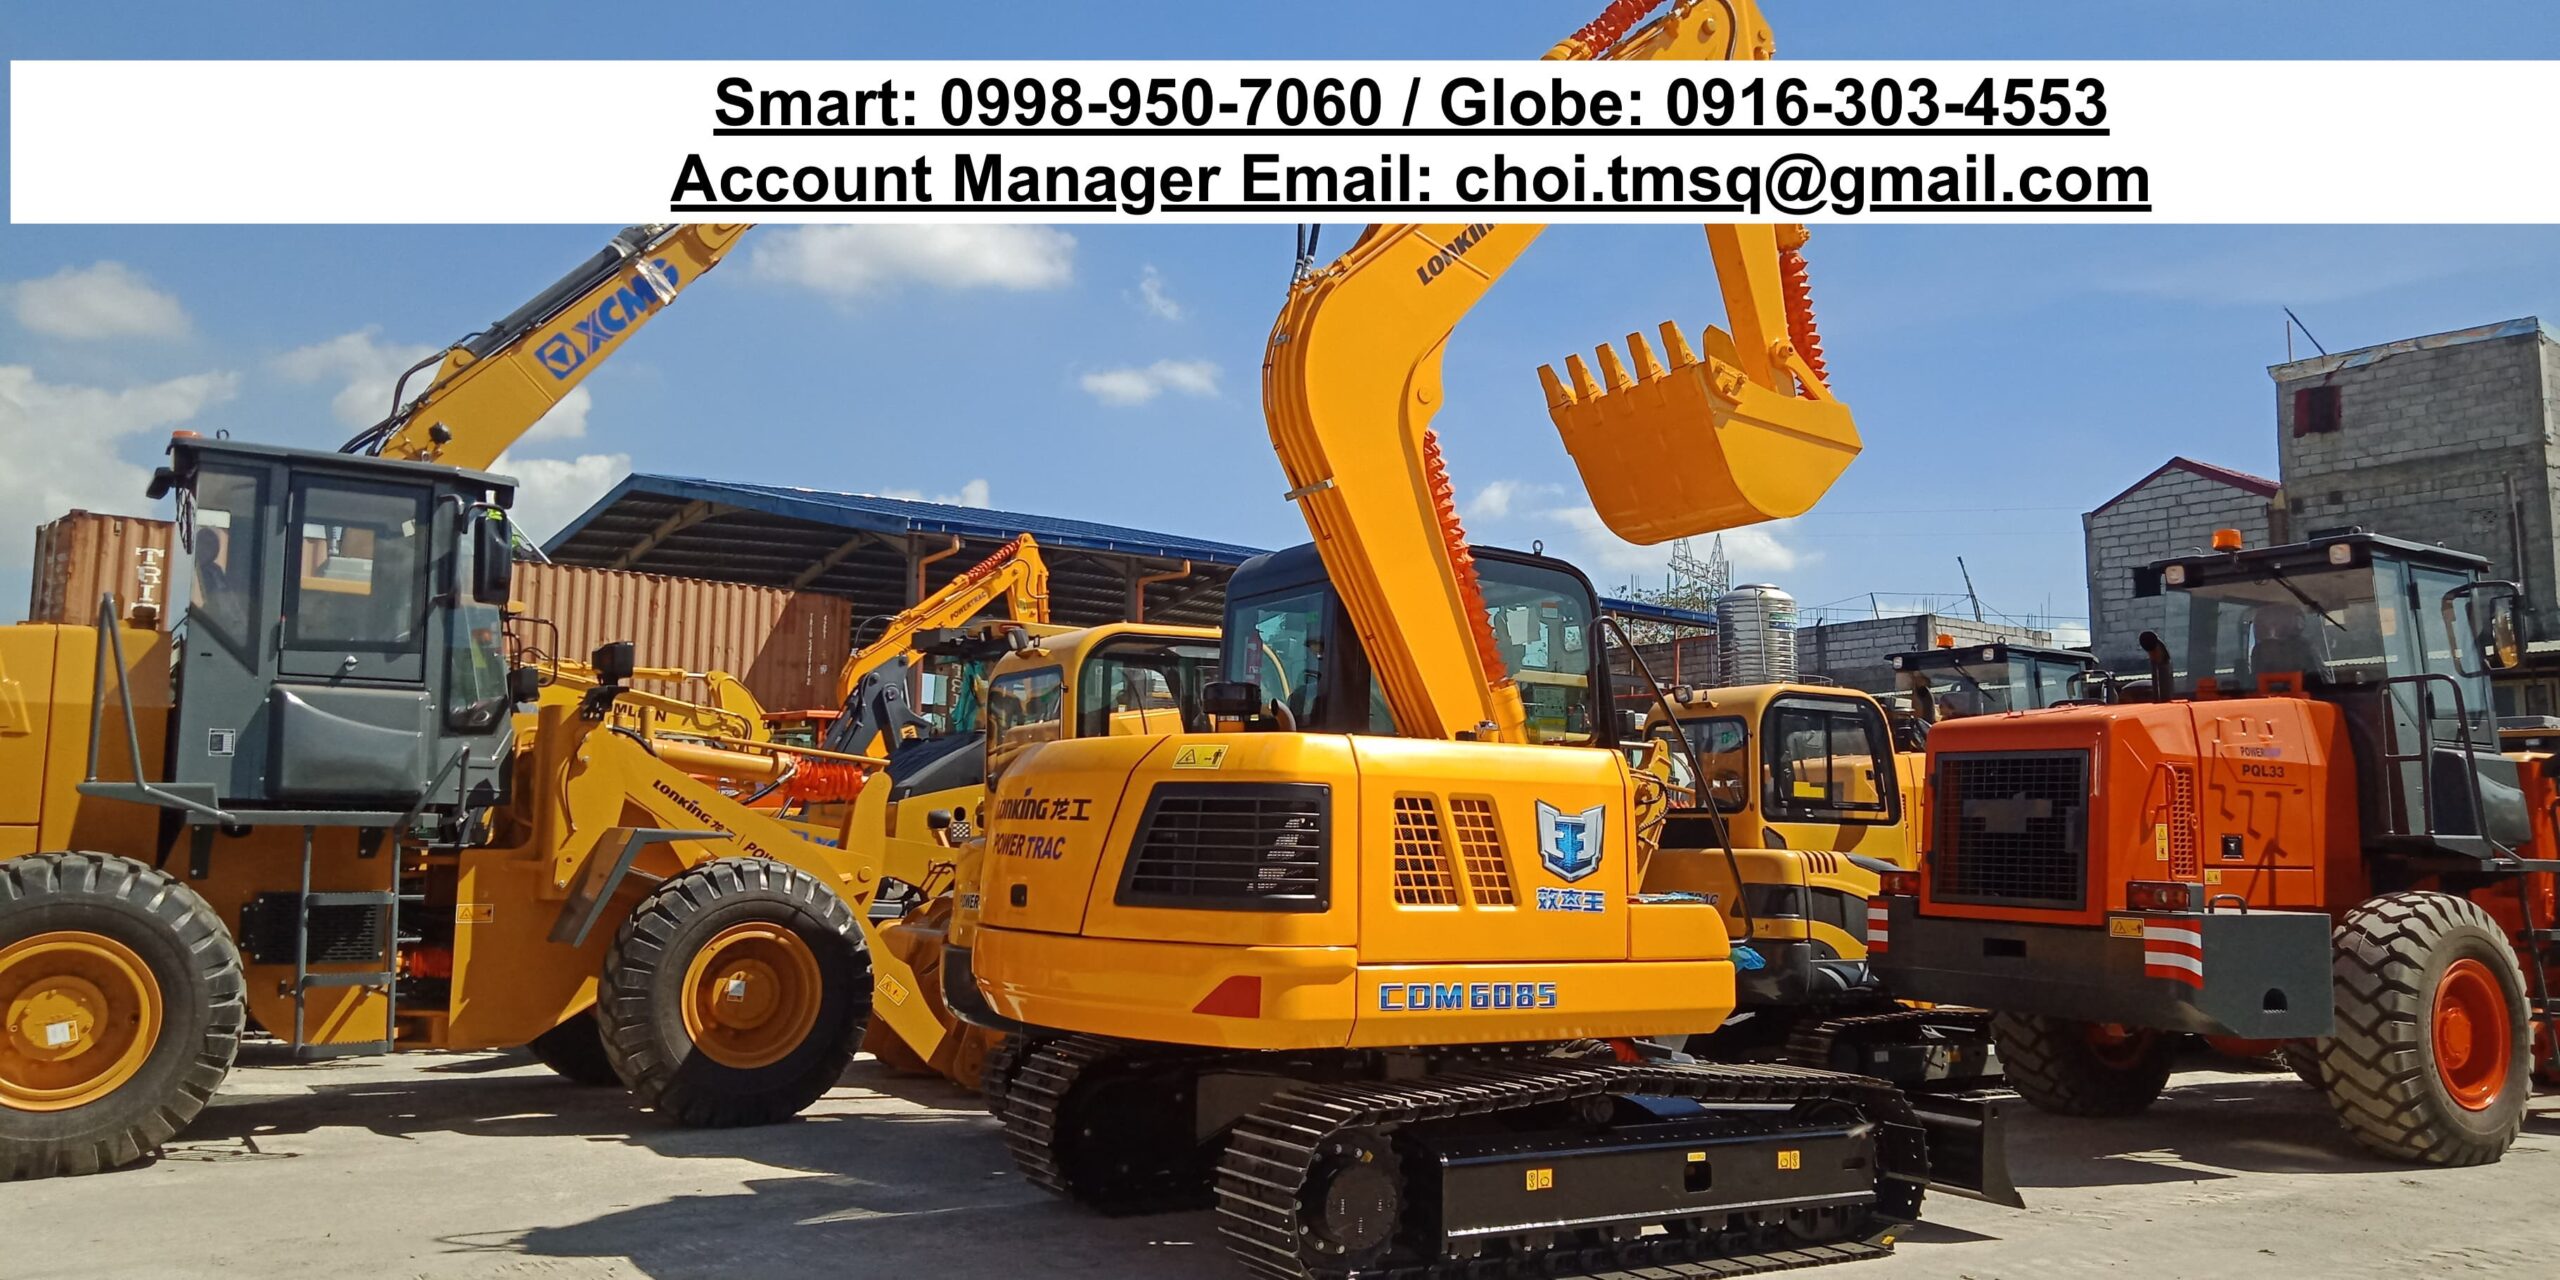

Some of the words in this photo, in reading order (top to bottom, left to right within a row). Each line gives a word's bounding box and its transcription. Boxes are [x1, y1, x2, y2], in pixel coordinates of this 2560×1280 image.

[2242, 765, 2285, 778] PQL33
[993, 833, 1026, 857] POWER
[1025, 836, 1066, 860] TRAC
[1469, 982, 1557, 1009] 6085
